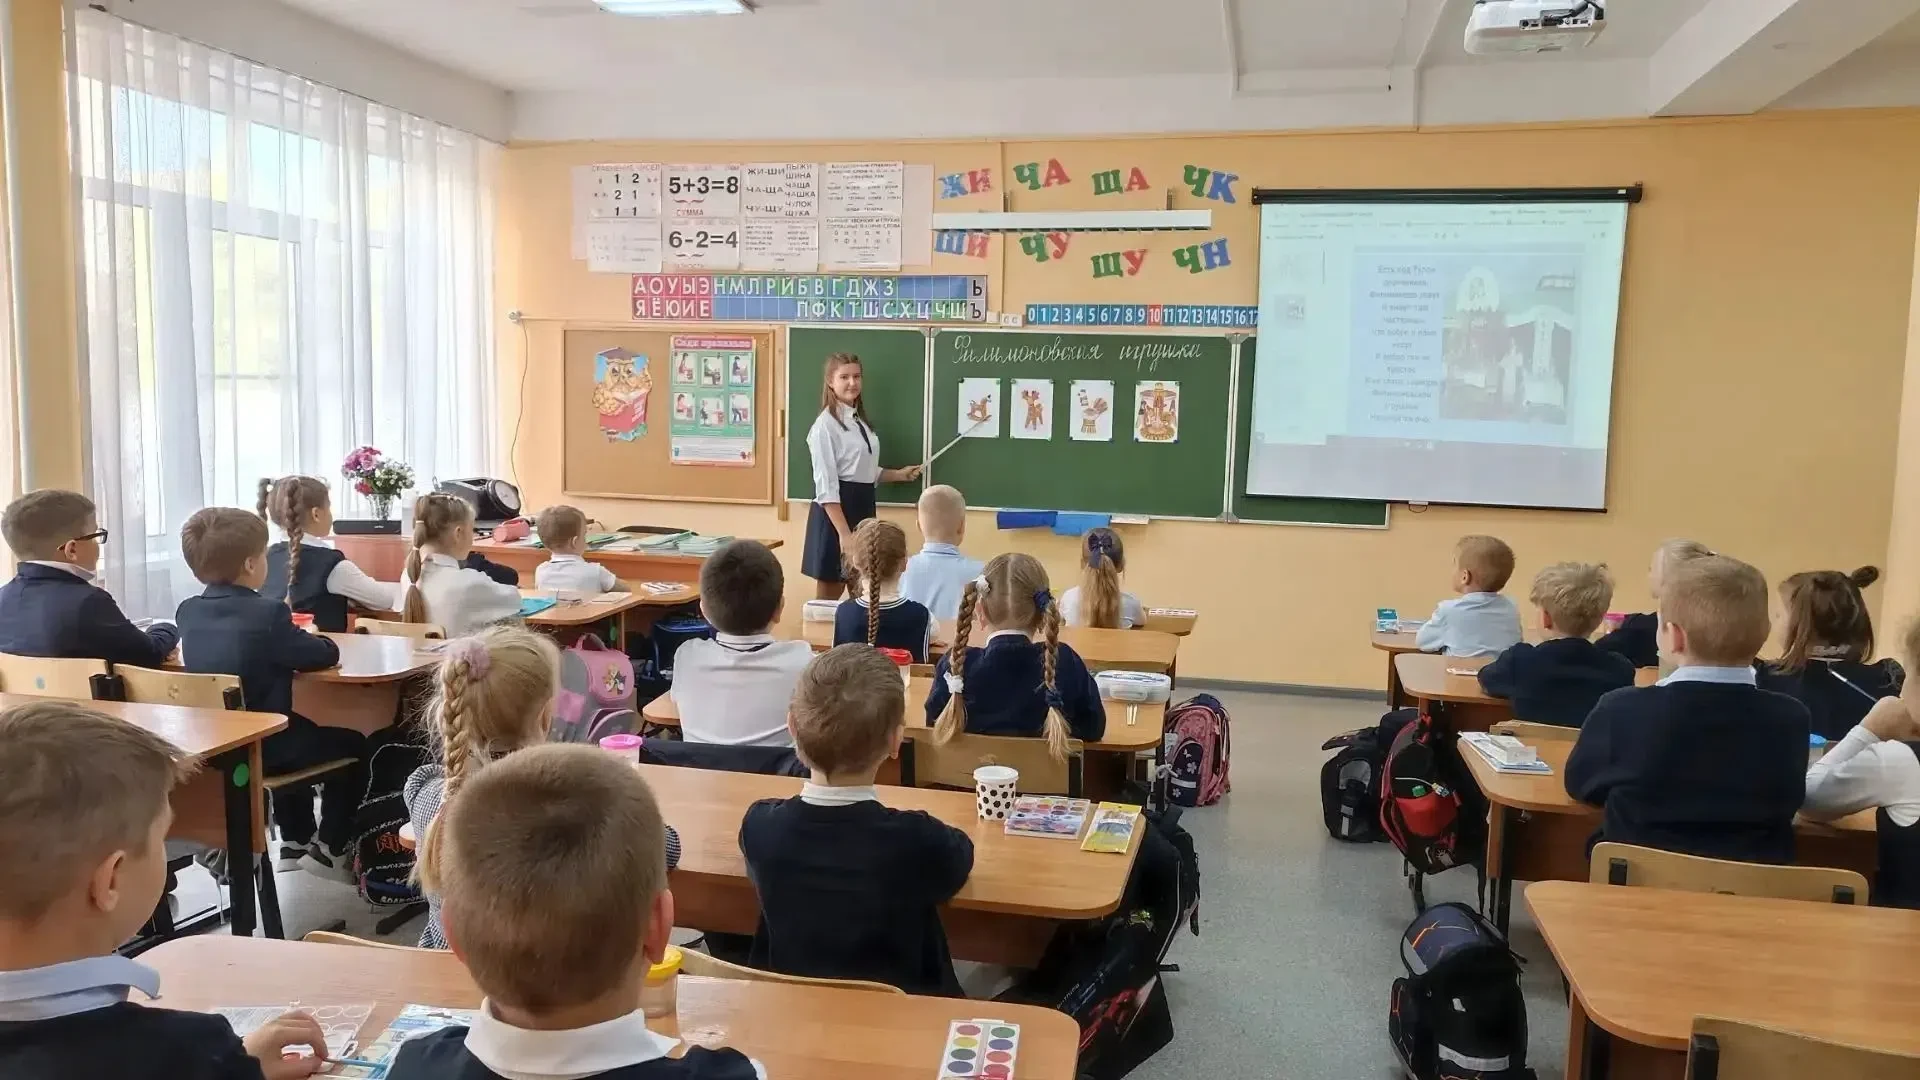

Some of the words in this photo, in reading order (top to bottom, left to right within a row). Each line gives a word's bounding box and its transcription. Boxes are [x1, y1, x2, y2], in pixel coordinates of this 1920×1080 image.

[614, 173, 620, 184] 1
[632, 173, 640, 184] 2
[747, 168, 785, 176] ЖИ-ШИ
[938, 167, 992, 199] ЖИ
[1013, 158, 1071, 191] ЧА
[1183, 163, 1240, 204] ЧК
[614, 189, 622, 200] 2
[632, 190, 638, 200] 1
[1019, 231, 1072, 263] ЧУ
[1173, 238, 1232, 273] ЧН
[1028, 308, 1035, 323] 0
[1041, 308, 1047, 323] 1
[1052, 308, 1060, 323] 2
[1064, 308, 1071, 323] 3
[1075, 308, 1083, 323] 4
[1088, 308, 1095, 323] 5
[1100, 308, 1107, 323] 6
[1113, 308, 1120, 323] 7
[1125, 308, 1132, 323] 8
[1137, 308, 1145, 323] 9
[1149, 308, 1160, 324] 10
[1163, 308, 1175, 324] 11
[1177, 308, 1189, 324] 12
[1191, 308, 1203, 324] 13
[1204, 308, 1217, 325] 14
[1219, 308, 1231, 325] 15
[1233, 308, 1246, 325] 16
[1119, 342, 1202, 373] игрушка
